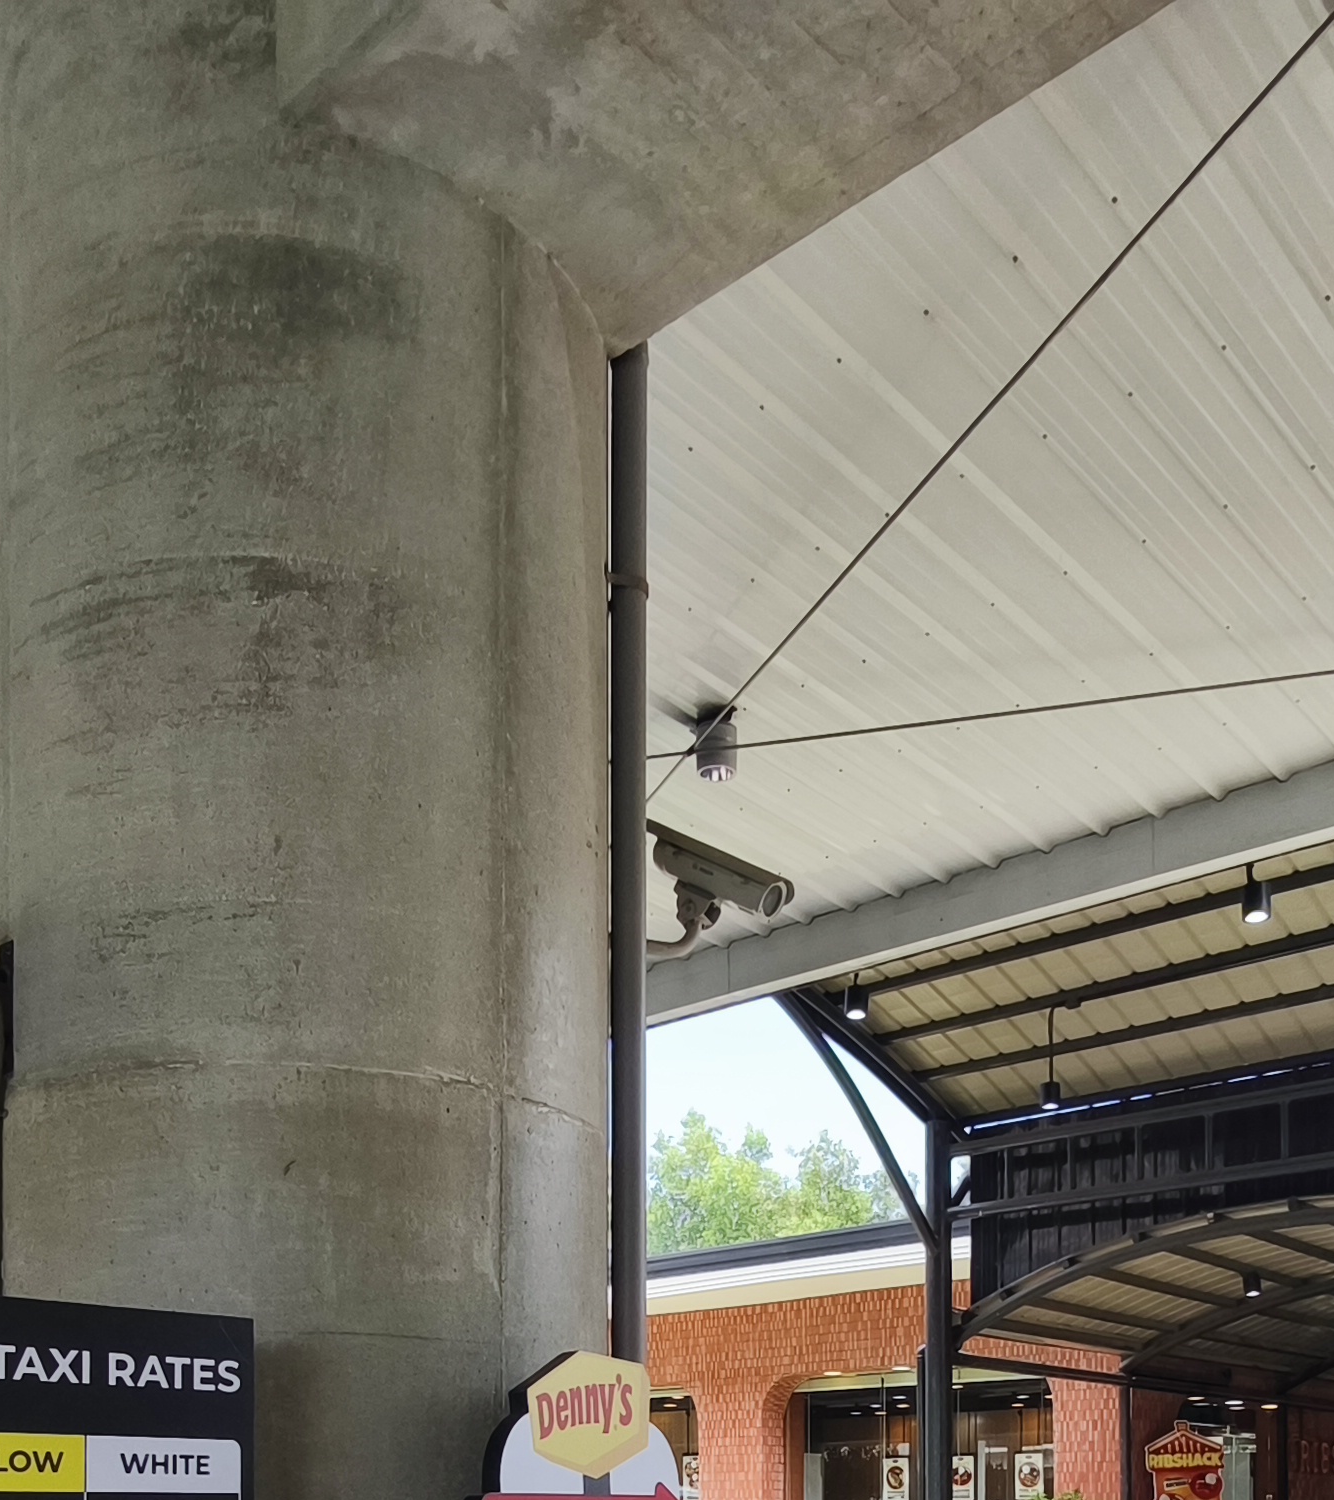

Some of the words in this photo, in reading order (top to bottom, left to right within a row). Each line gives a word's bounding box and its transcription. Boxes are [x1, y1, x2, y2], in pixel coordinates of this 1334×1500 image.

[108, 1352, 241, 1393] RATES
[536, 1373, 633, 1440] Denny's
[120, 1453, 211, 1476] WHITE
